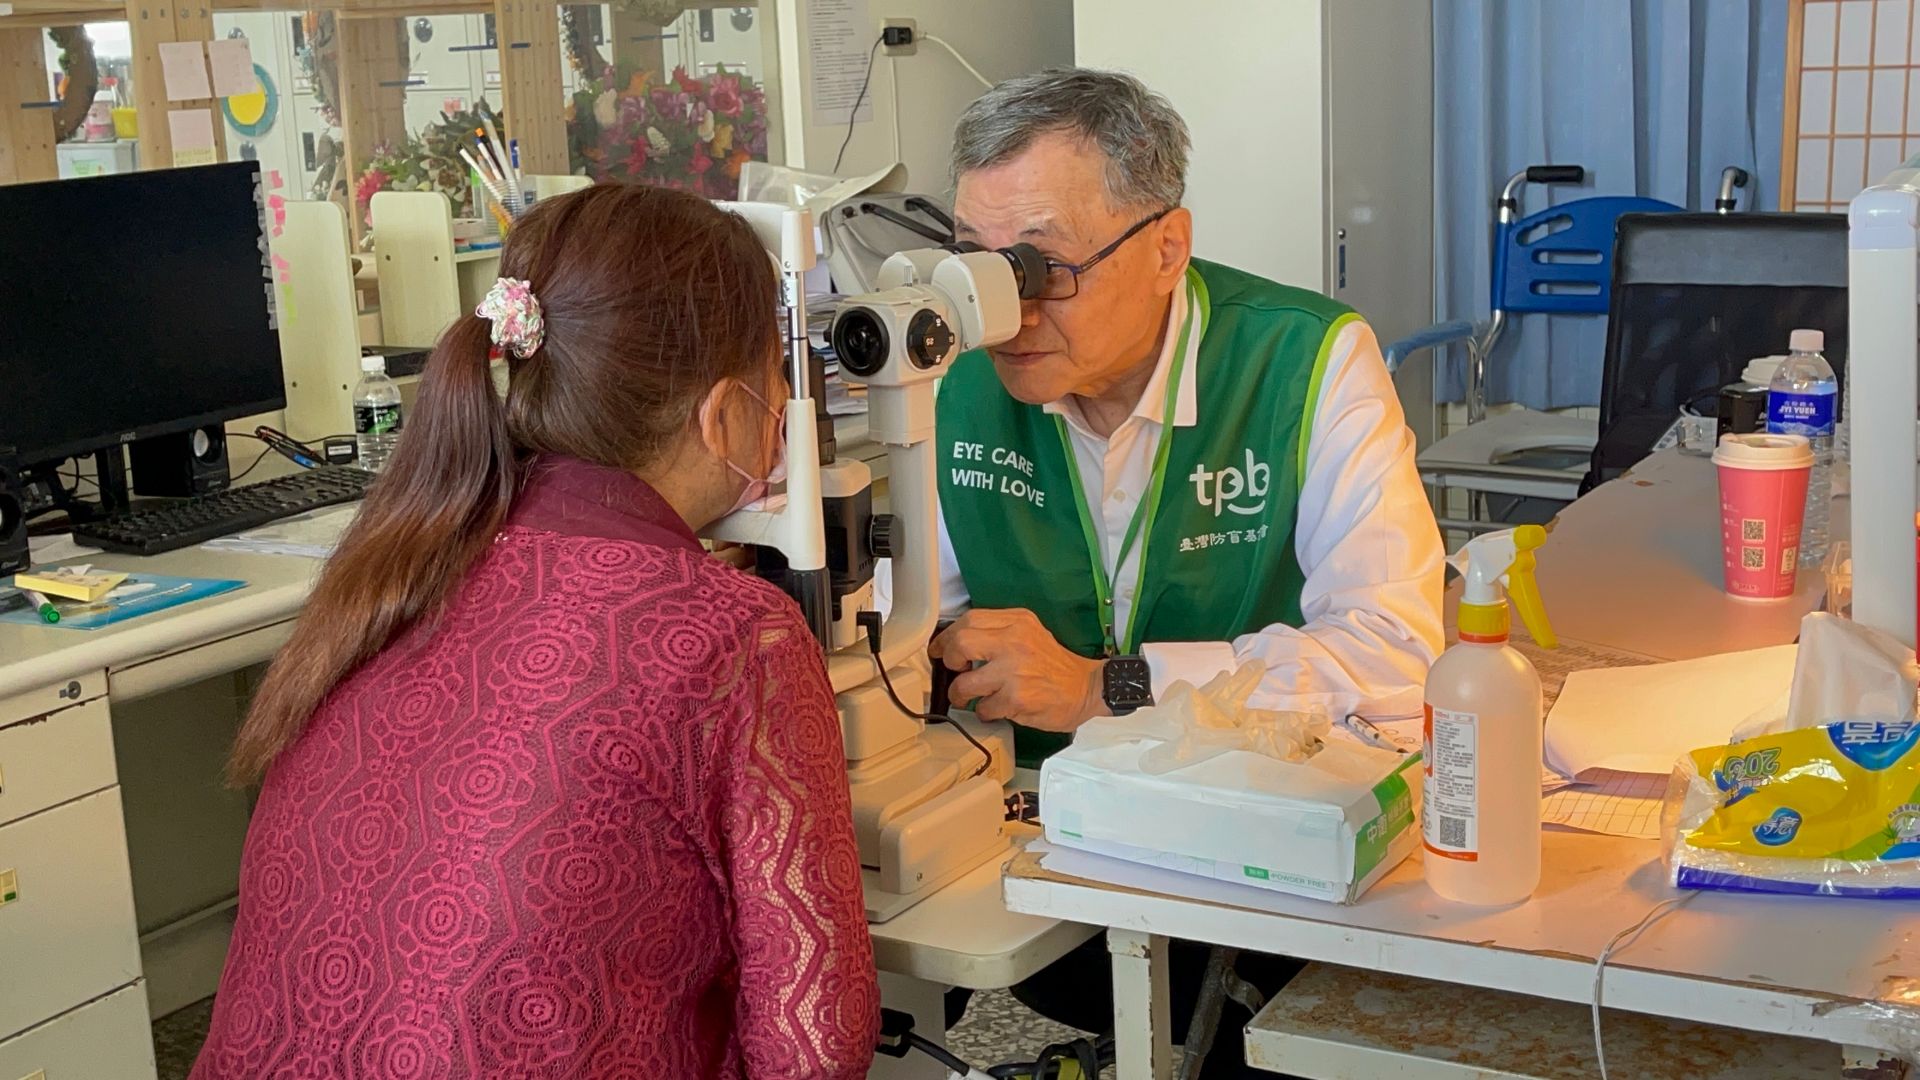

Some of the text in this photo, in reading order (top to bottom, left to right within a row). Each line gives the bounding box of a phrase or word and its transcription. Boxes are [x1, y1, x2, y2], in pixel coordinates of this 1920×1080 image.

[953, 441, 1034, 478] EYE CARE
[951, 468, 1045, 508] WITH LOVE
[1189, 448, 1271, 517] tpb
